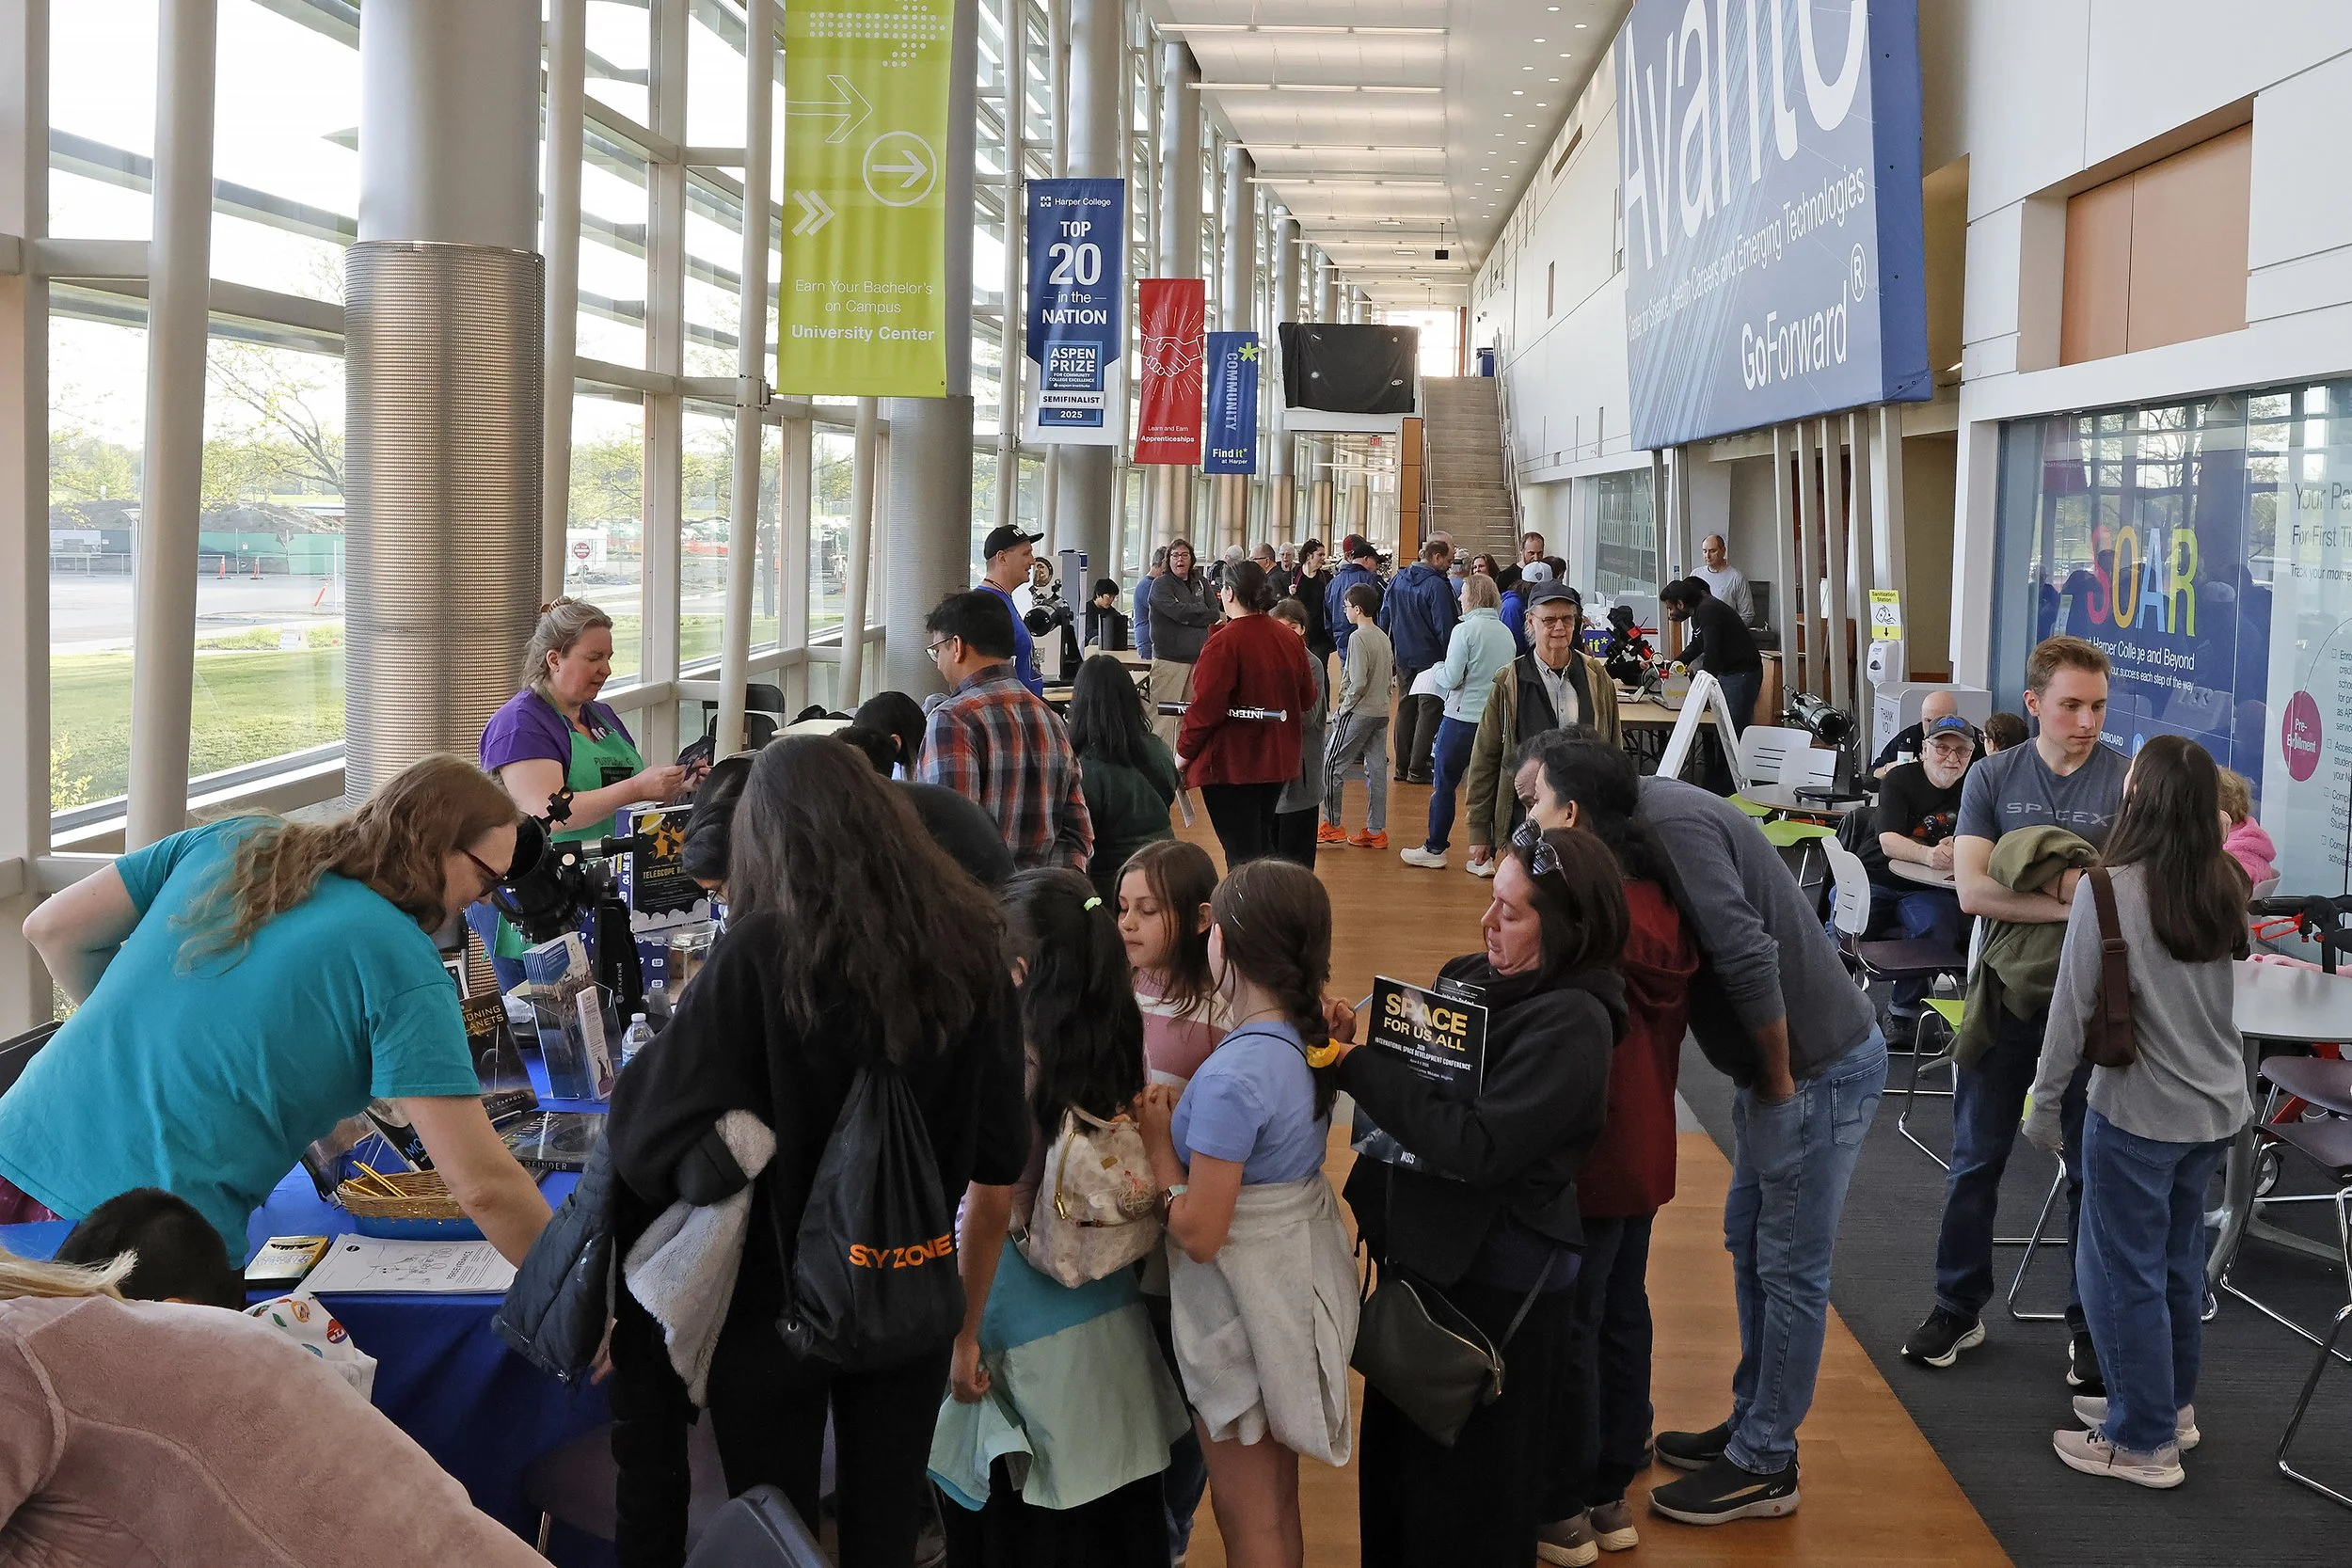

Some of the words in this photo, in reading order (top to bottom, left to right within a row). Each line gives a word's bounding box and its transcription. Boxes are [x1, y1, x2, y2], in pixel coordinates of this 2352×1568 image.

[1055, 198, 1081, 206] Harper
[1082, 198, 1111, 207] College
[1059, 221, 1091, 237] TOP
[1692, 260, 1720, 300] Careers
[1721, 242, 1736, 282] and
[1737, 215, 1782, 273] Emerging
[1784, 165, 1865, 245] Technologies
[1048, 243, 1102, 285] 20
[795, 279, 825, 293] Earn
[830, 280, 859, 293] Your
[864, 280, 932, 294] Bachelor's
[1057, 291, 1068, 303] in
[1071, 291, 1091, 303] the
[825, 301, 841, 312] on
[846, 299, 901, 315] Campus
[1041, 309, 1107, 325] NATION
[791, 324, 873, 342] University
[878, 325, 935, 341] Center
[1050, 347, 1096, 359] ASPEN
[1049, 359, 1095, 372] PRIZE
[1042, 395, 1101, 404] SEMIFINALIST
[1225, 352, 1239, 431] COMMUNITY
[1060, 410, 1083, 419] 2025
[1141, 435, 1195, 443] Apprenticeships
[1212, 448, 1234, 458] Find
[2295, 483, 2326, 510] Your
[2292, 524, 2309, 546] For
[2312, 525, 2336, 547] First
[2087, 525, 2198, 637] SOAR
[2118, 640, 2145, 664] College
[2146, 647, 2162, 664] and
[2163, 648, 2195, 672] Beyond
[2110, 666, 2120, 675] our
[2140, 672, 2153, 683] each
[2153, 673, 2165, 688] step
[2166, 674, 2172, 687] of
[2172, 677, 2183, 689] the
[2183, 681, 2195, 694] way
[2295, 718, 2308, 733] Pre-
[2099, 730, 2124, 747] ONBOARD
[2006, 802, 2118, 827] SPCEX
[643, 866, 675, 879] TELESCOPE
[464, 1005, 501, 1022] IONING
[1385, 992, 1468, 1037] SPACE
[469, 1013, 504, 1031] ANETS
[1383, 1016, 1410, 1035] FOR
[1413, 1025, 1433, 1042] US
[1435, 1034, 1466, 1052] ALL
[1402, 1045, 1415, 1055] SPACE
[1414, 1050, 1442, 1064] DEVELOPMENT
[1400, 1150, 1416, 1164] NSS
[524, 1161, 568, 1171] RFINDER
